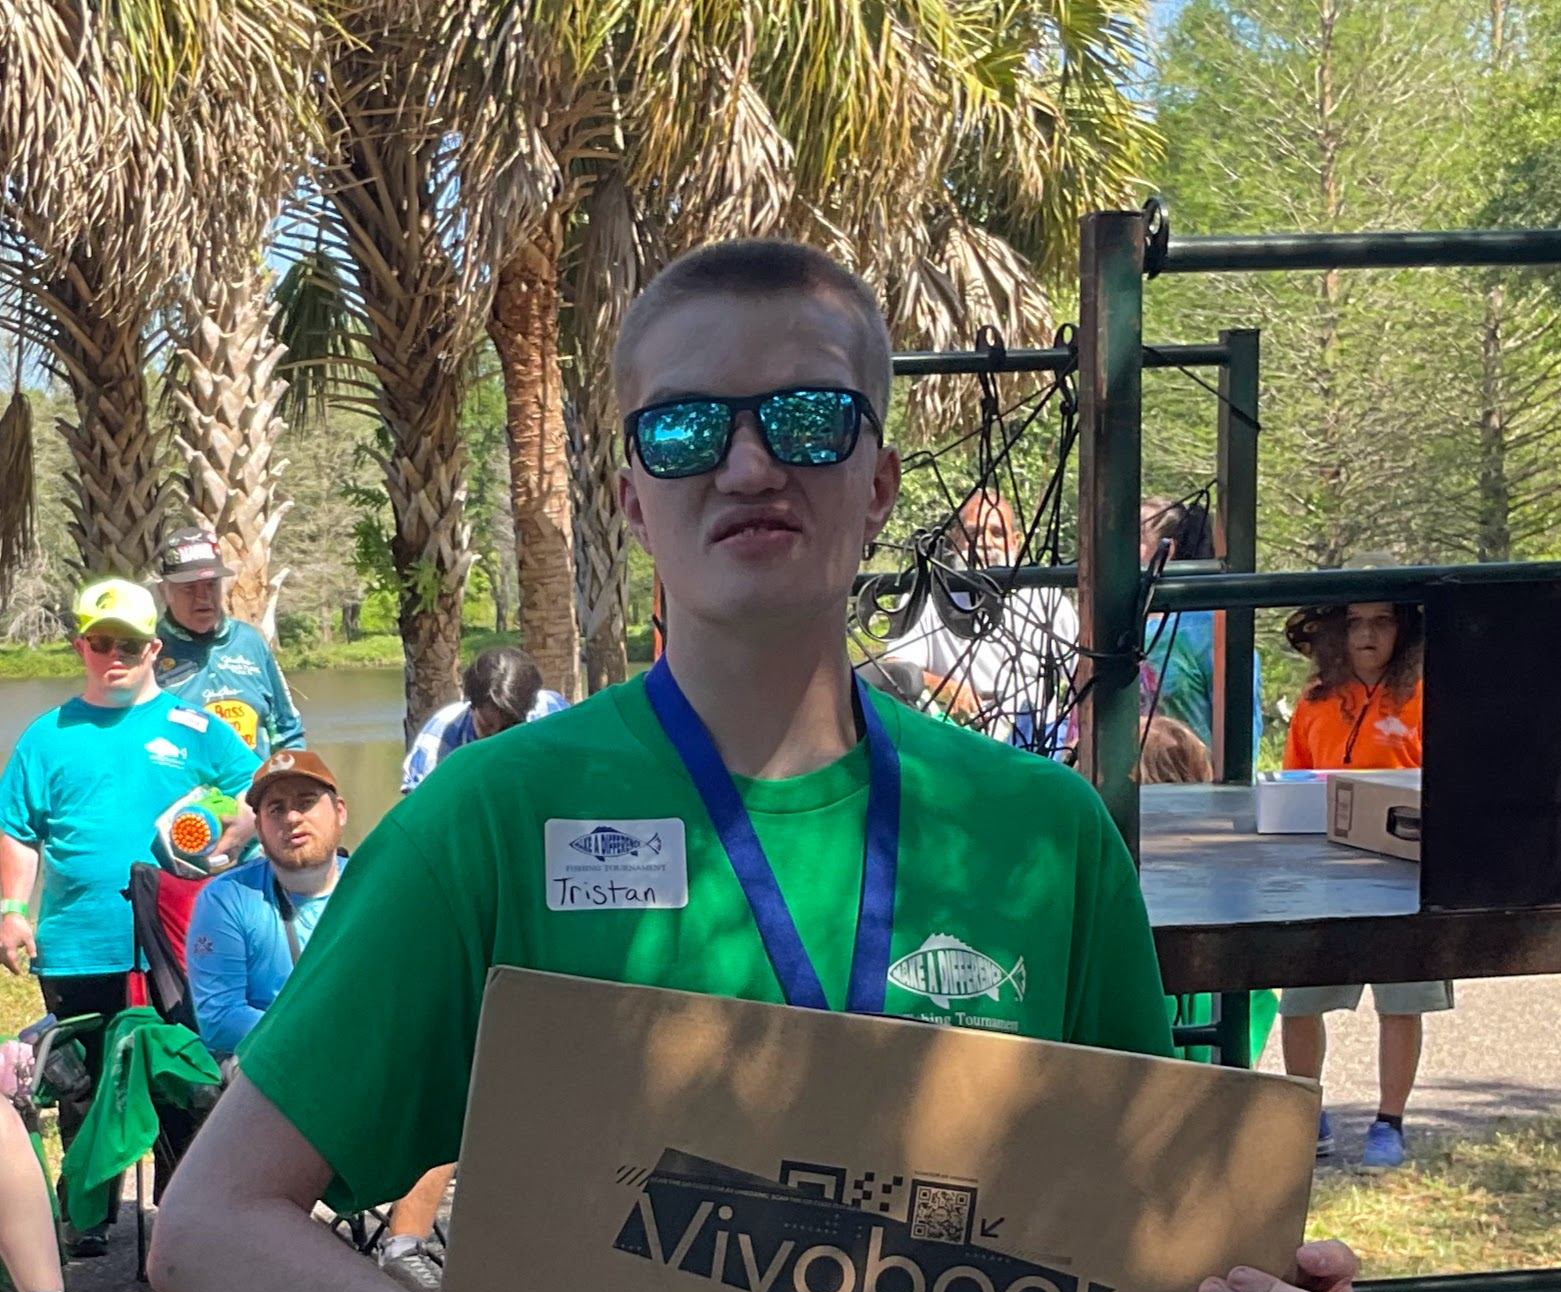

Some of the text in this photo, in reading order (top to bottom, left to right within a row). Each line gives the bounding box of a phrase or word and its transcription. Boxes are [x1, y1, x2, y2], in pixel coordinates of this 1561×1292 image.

[604, 863, 667, 873] TOURNAMENT
[552, 877, 658, 906] Tristan
[926, 951, 940, 994] A
